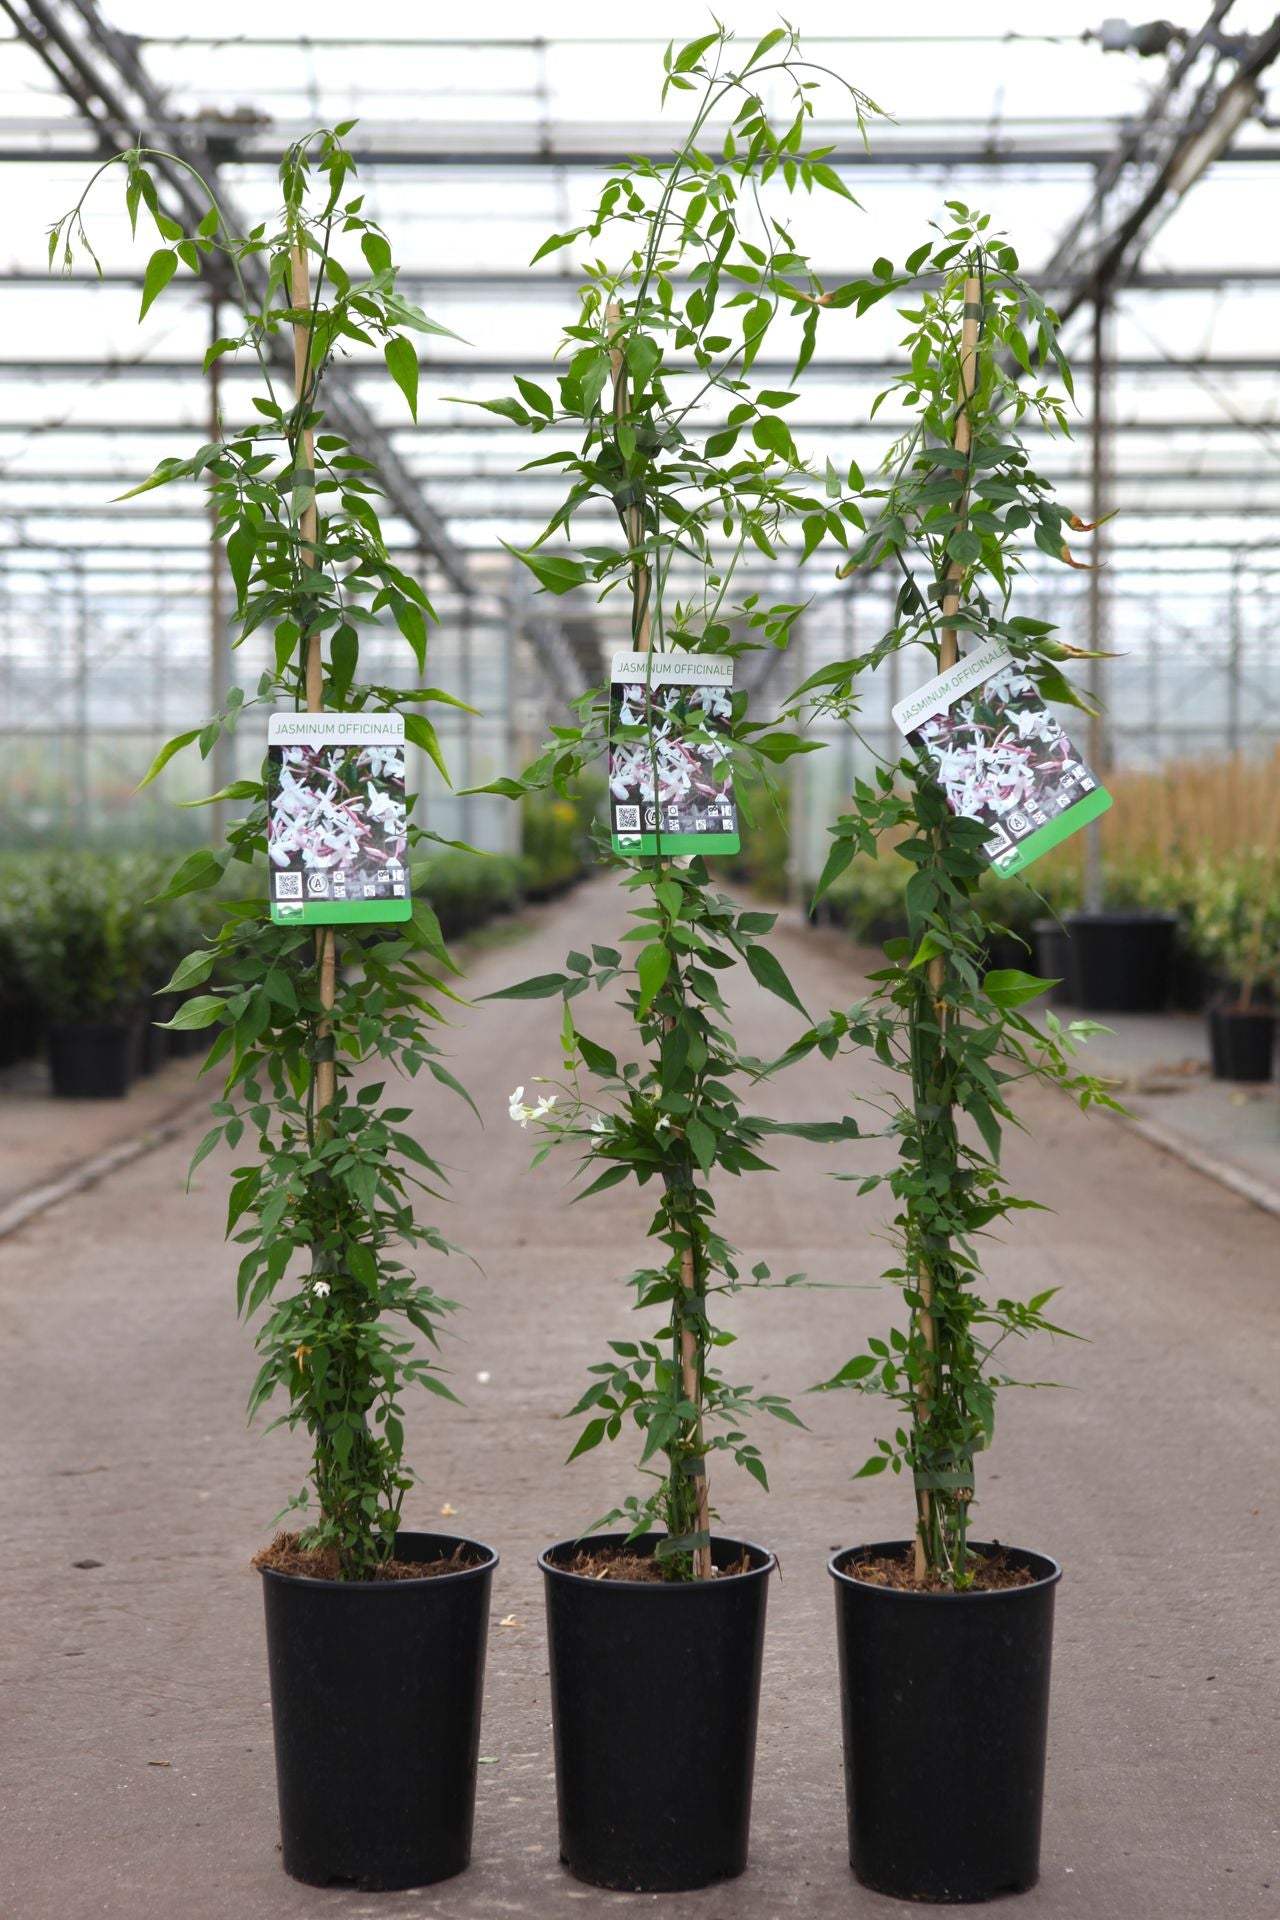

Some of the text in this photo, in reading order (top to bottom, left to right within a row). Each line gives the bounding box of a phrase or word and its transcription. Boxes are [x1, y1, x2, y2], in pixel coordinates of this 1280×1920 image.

[618, 662, 733, 675] JASMINUM OFFICINALE
[902, 643, 1008, 723] JASMINUM OFFICINALE
[275, 723, 403, 735] JASMINUM OFFICINALE
[314, 878, 322, 888] A
